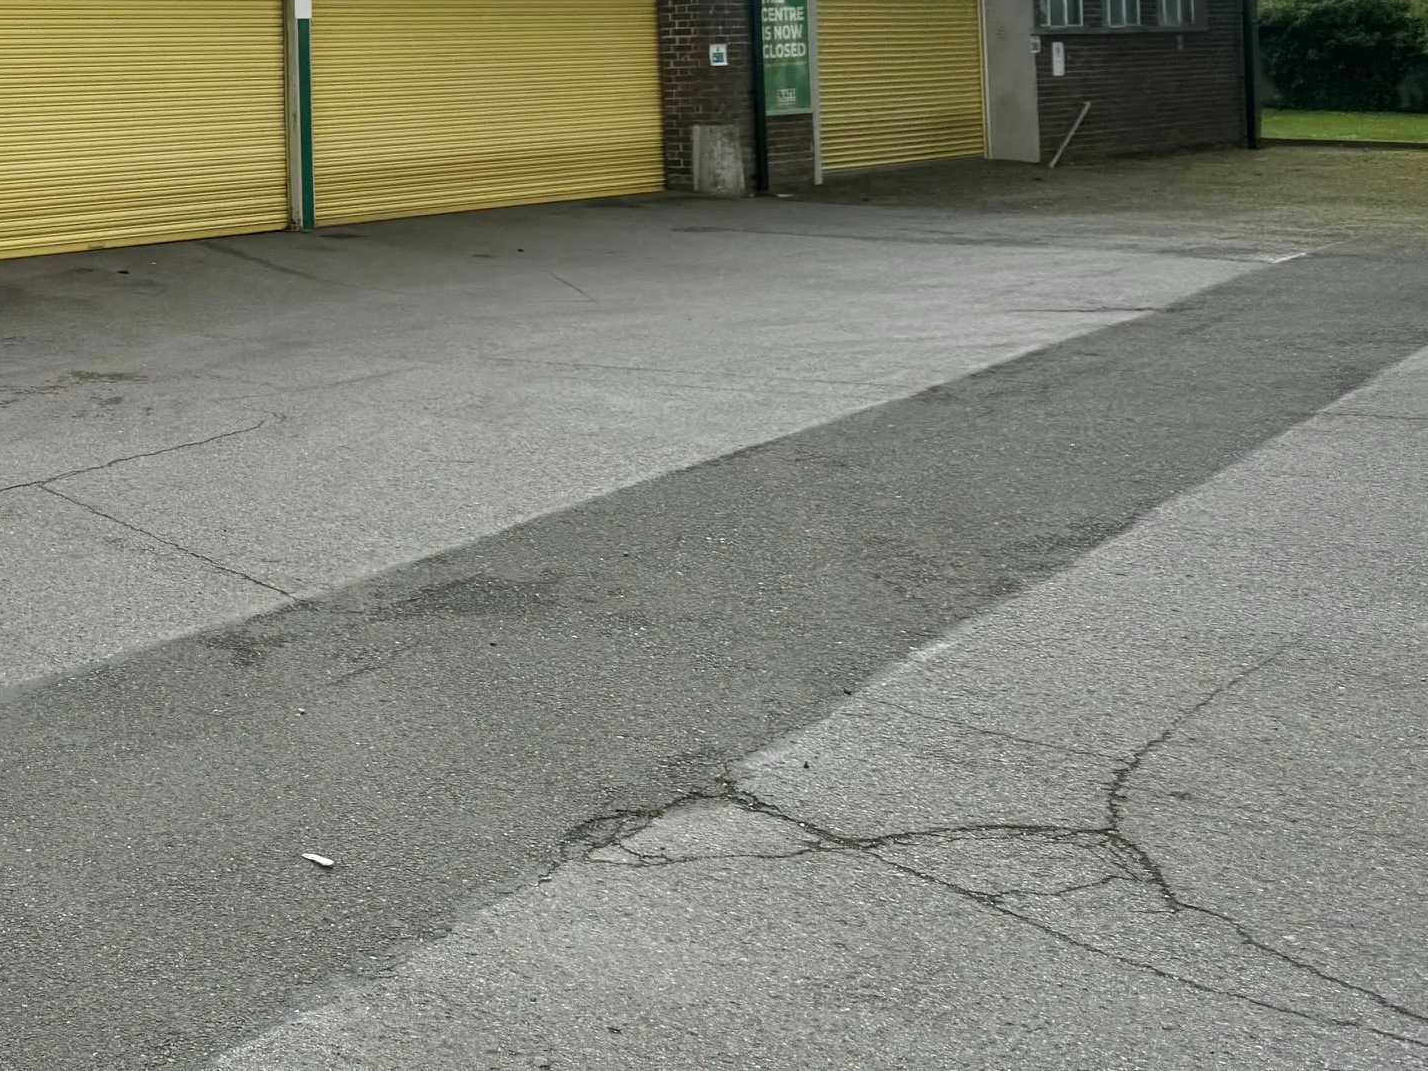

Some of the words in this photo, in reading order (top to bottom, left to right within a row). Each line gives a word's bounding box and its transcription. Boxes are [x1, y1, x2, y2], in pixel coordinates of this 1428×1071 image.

[761, 6, 804, 22] CENTRE
[762, 25, 771, 41] IS
[773, 24, 803, 40] NOW
[762, 43, 807, 59] CLOSED
